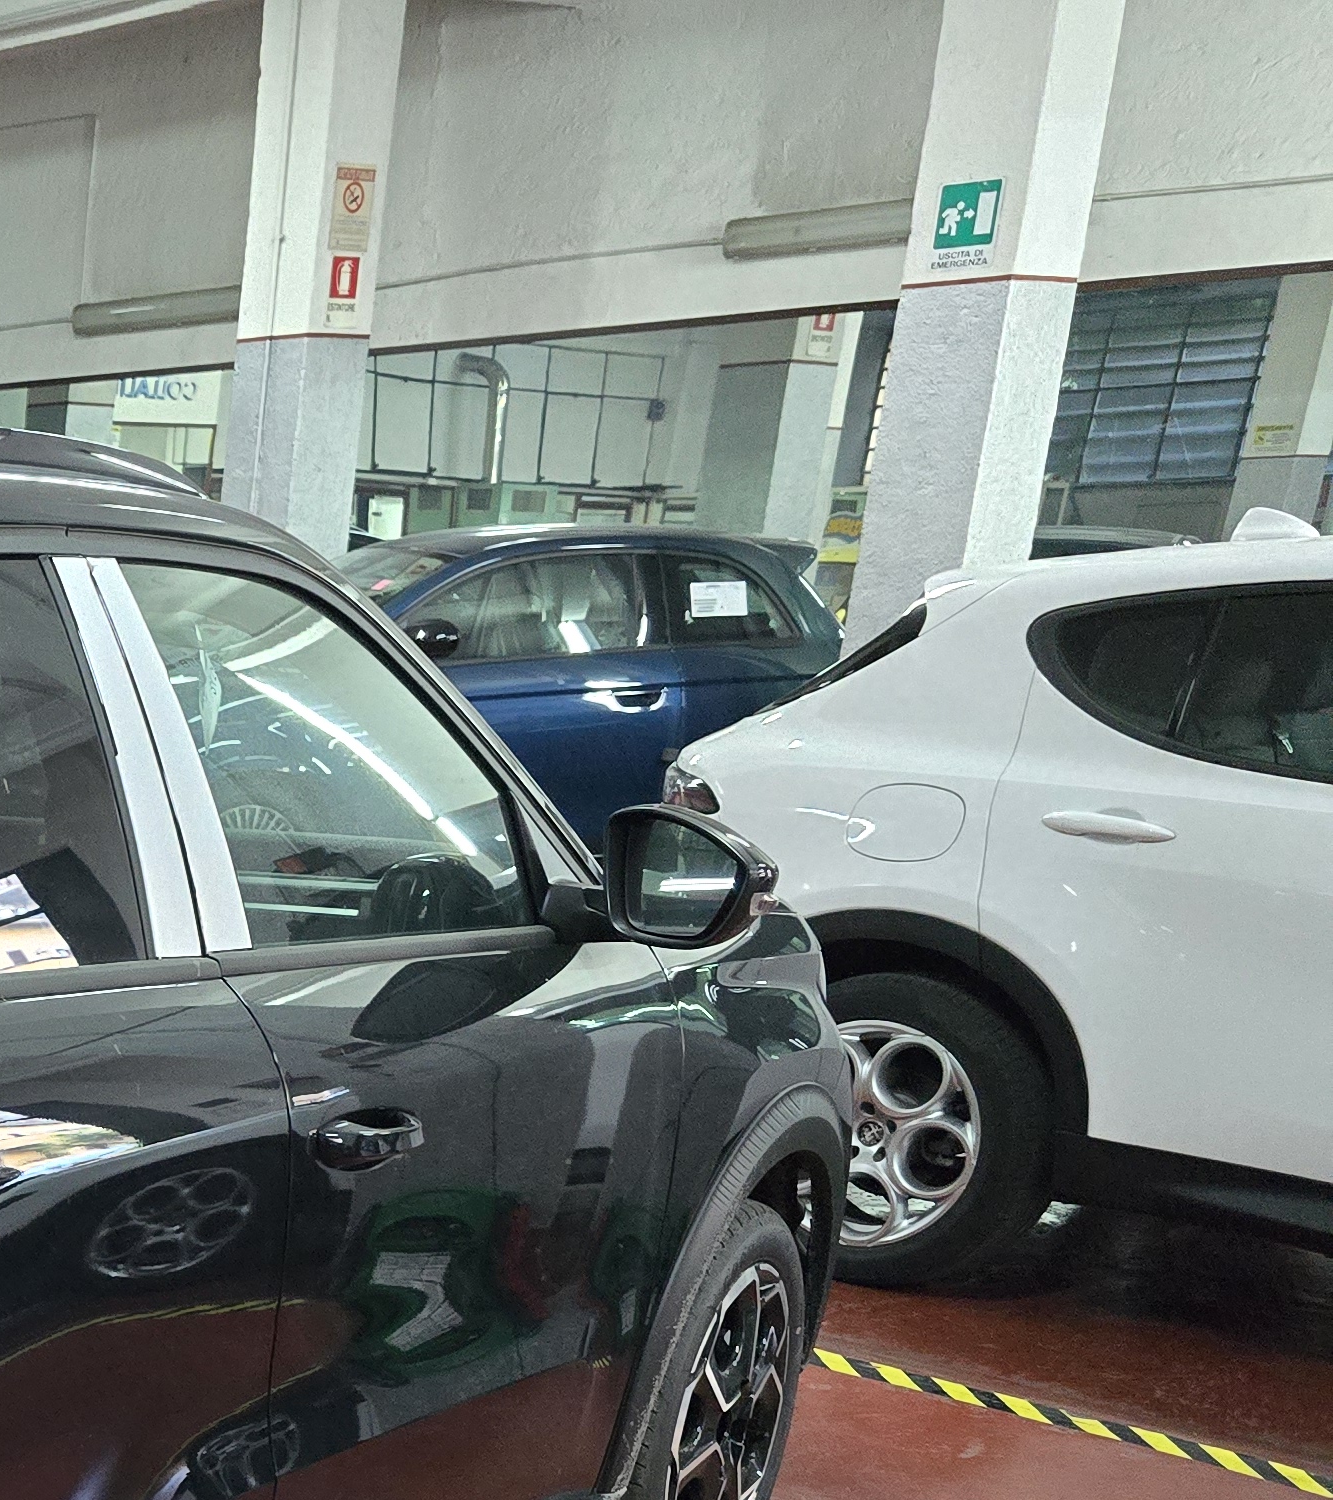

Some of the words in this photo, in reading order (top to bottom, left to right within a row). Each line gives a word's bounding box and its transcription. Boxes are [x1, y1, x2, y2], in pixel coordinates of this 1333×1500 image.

[938, 250, 971, 260] USCITA
[974, 249, 984, 257] DI
[930, 257, 988, 270] EMERGENZA
